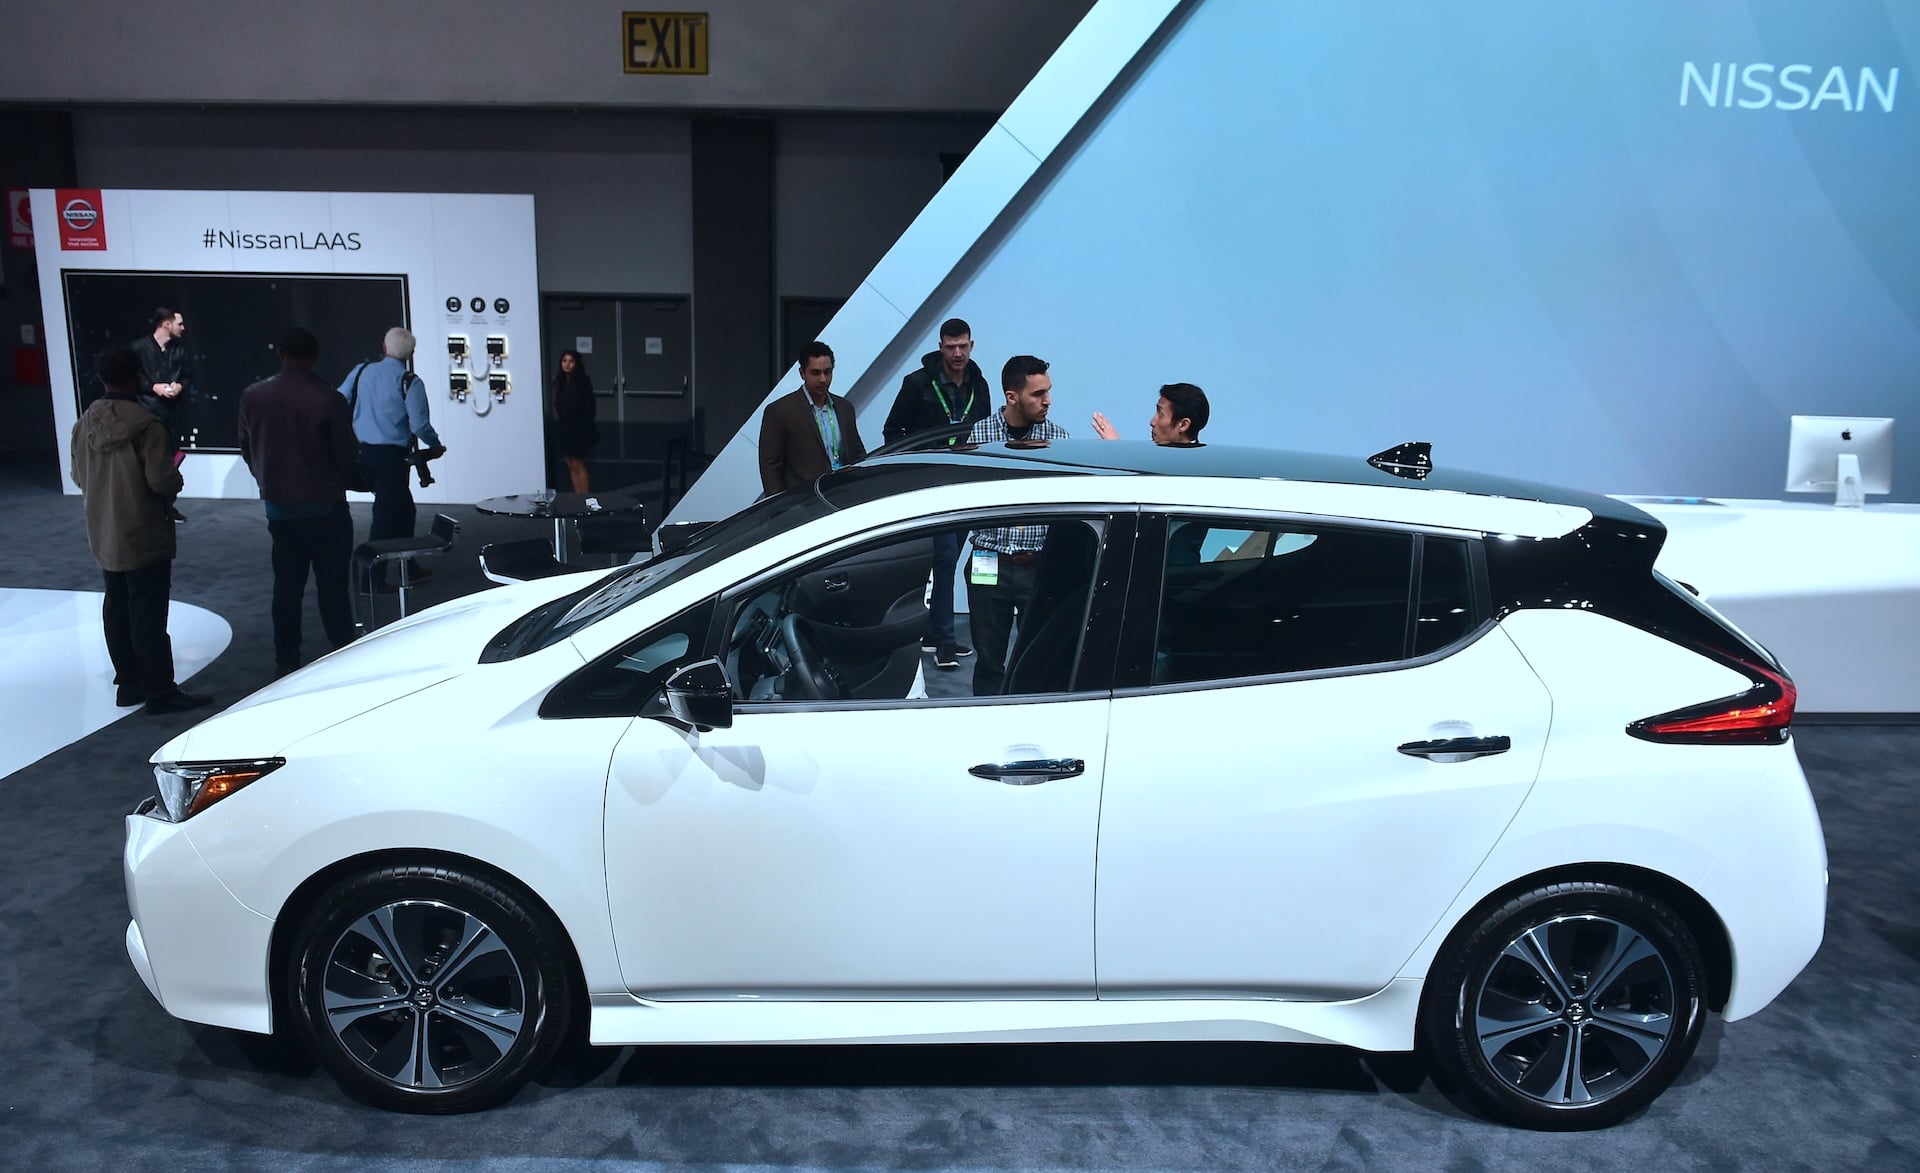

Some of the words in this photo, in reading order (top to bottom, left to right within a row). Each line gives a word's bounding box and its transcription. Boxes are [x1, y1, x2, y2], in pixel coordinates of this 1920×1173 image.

[628, 17, 703, 68] EXIT
[1679, 61, 1900, 112] NISSAN
[203, 228, 362, 251] #NissanLAAS
